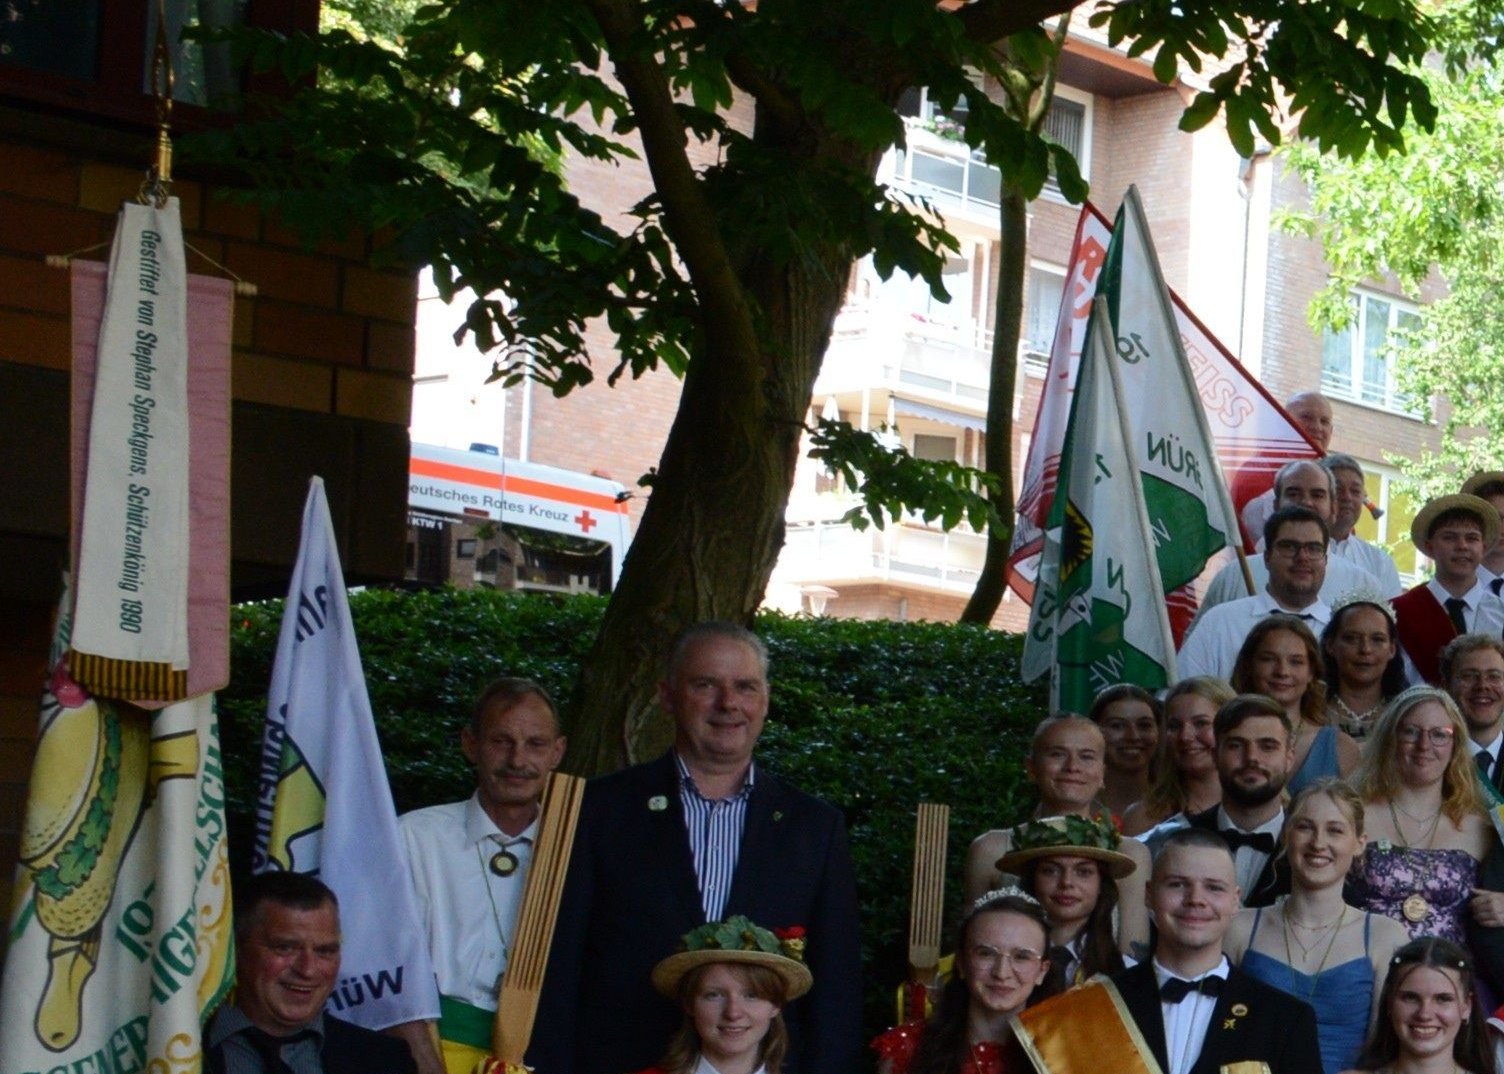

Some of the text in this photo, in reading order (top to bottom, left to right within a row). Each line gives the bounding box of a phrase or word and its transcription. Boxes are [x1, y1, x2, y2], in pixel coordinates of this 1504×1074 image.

[140, 230, 161, 295] Gestiftet
[137, 300, 154, 327] von
[130, 330, 158, 391] Stephan
[409, 483, 569, 523] eutsches Rotes Kreuz
[118, 483, 150, 592] Schützenkönig
[119, 598, 143, 634] 1990
